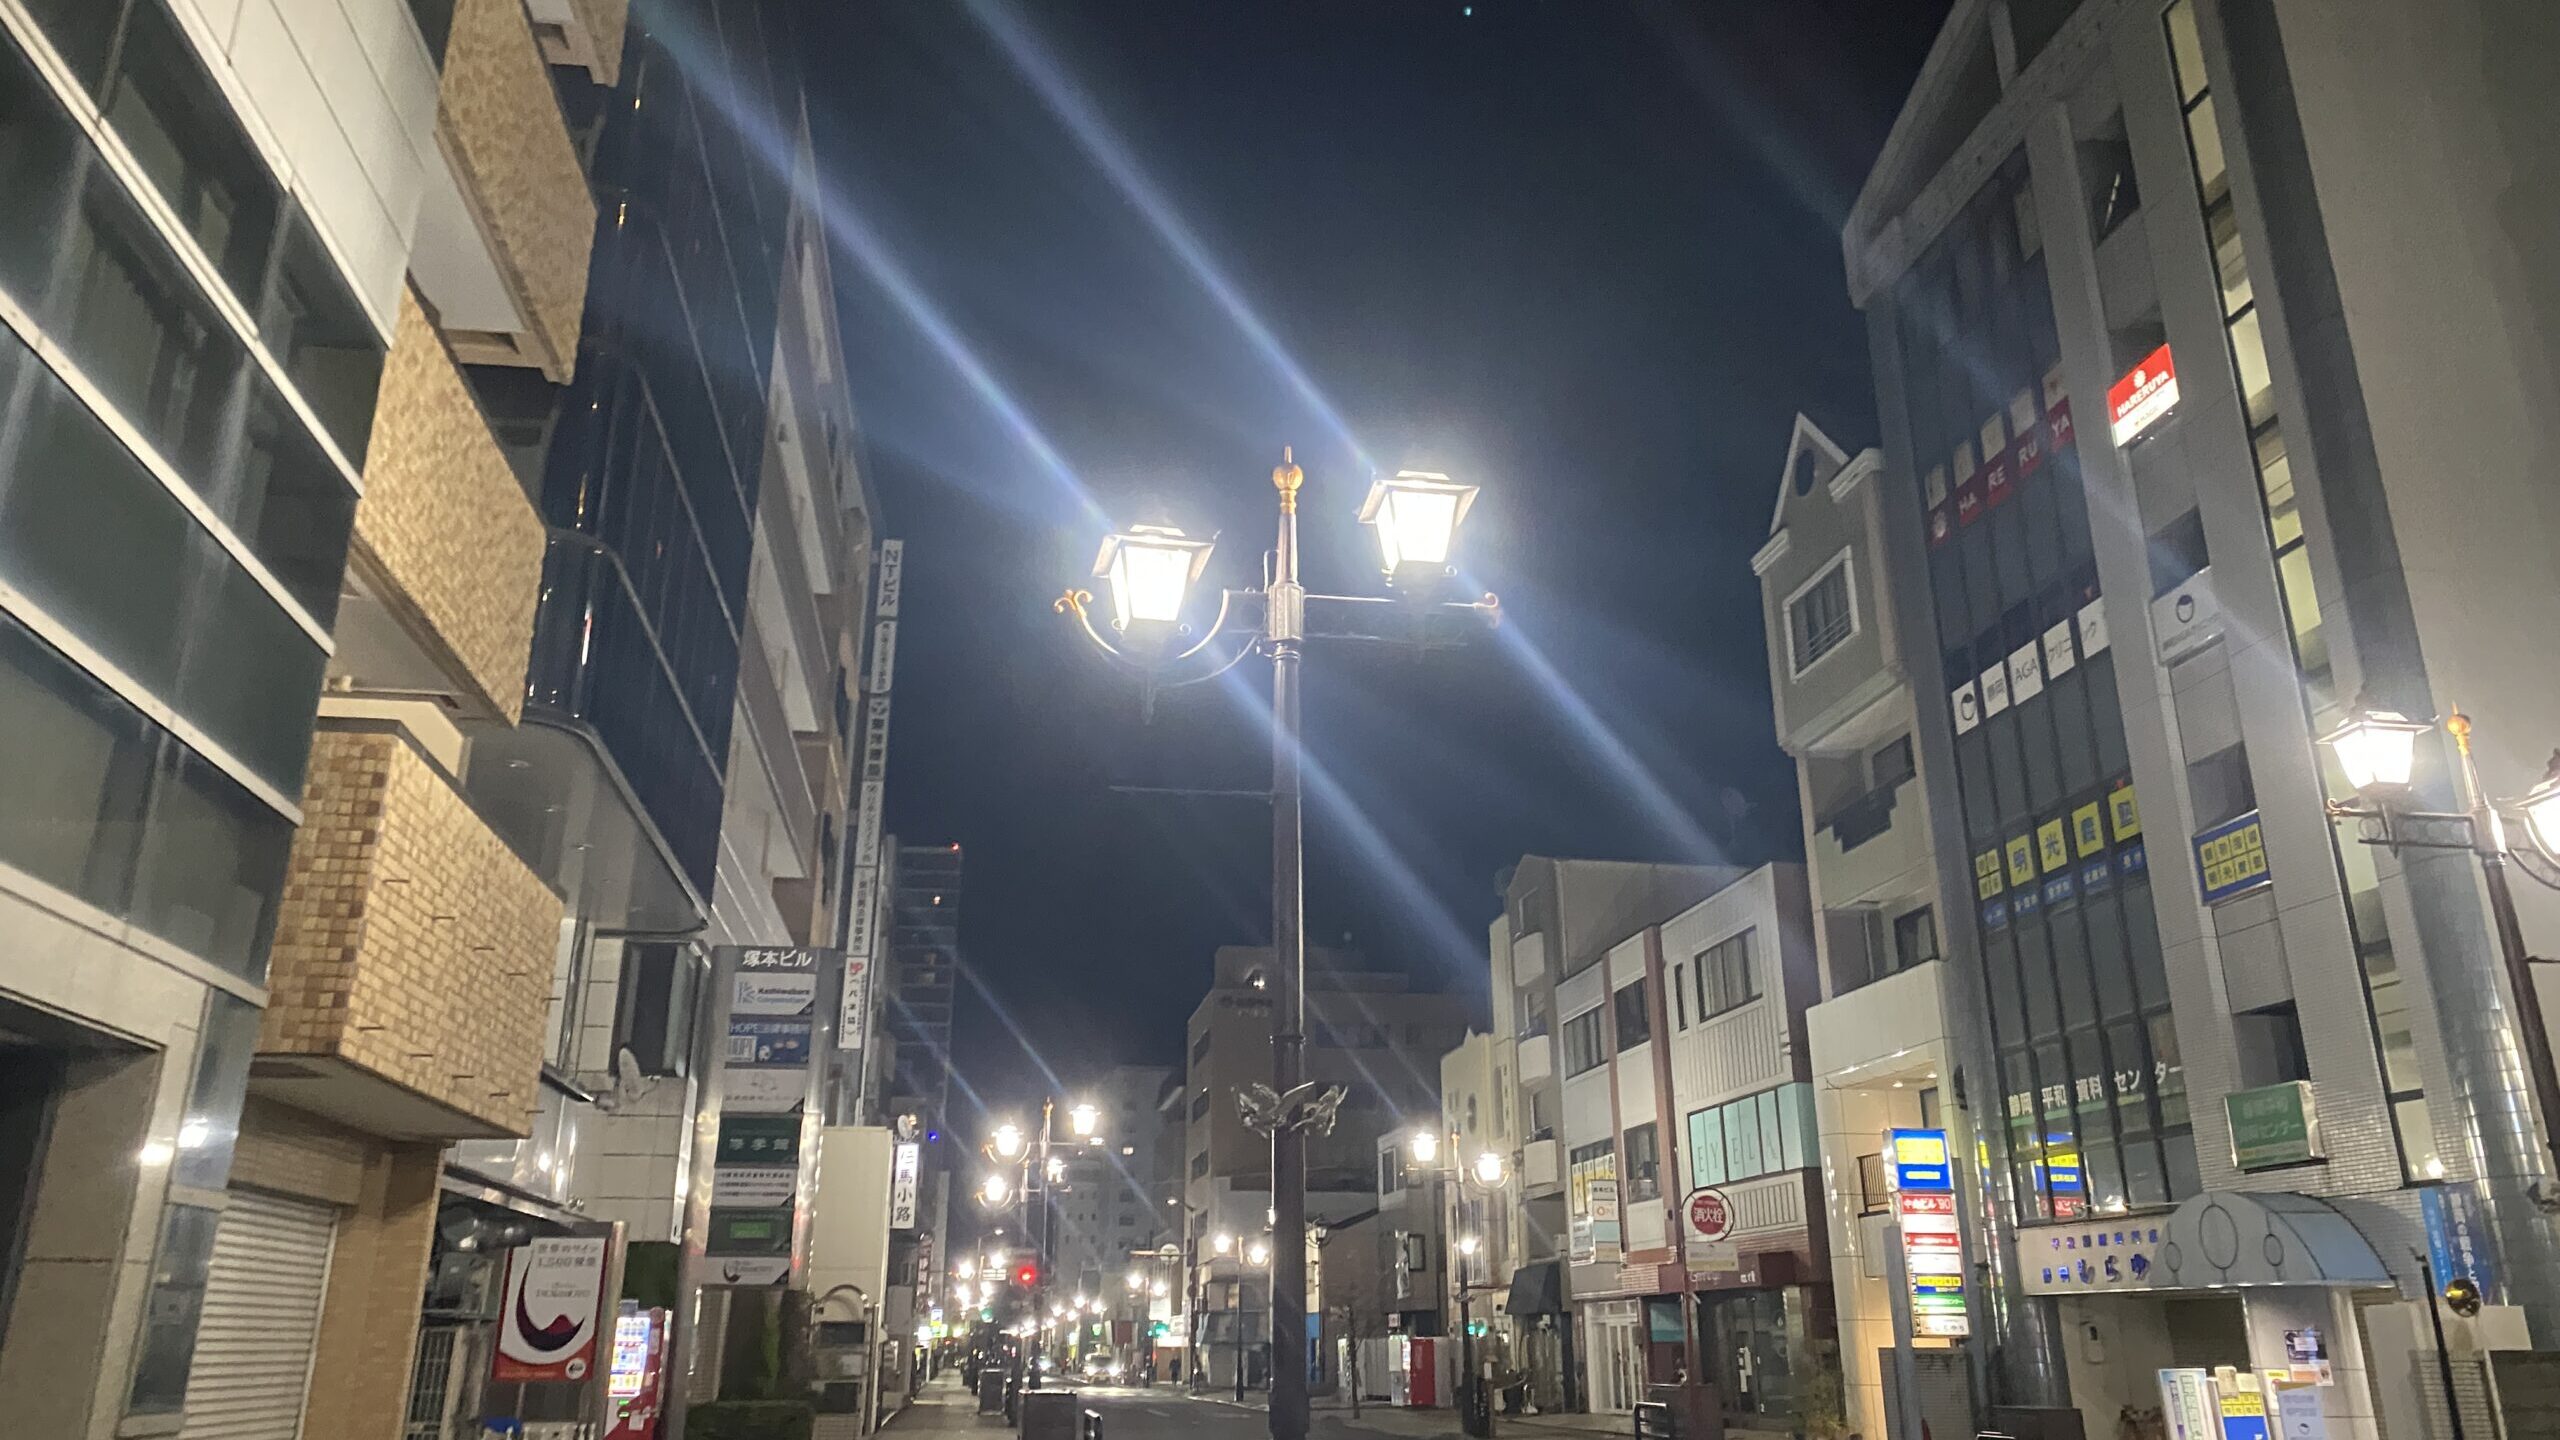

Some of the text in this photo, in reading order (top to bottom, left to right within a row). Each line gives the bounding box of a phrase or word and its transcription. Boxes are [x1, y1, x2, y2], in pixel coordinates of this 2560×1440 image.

[2116, 370, 2170, 418] HARERUYA
[743, 949, 813, 968] 塚本ビル
[1694, 1207, 1724, 1223] 消火栓
